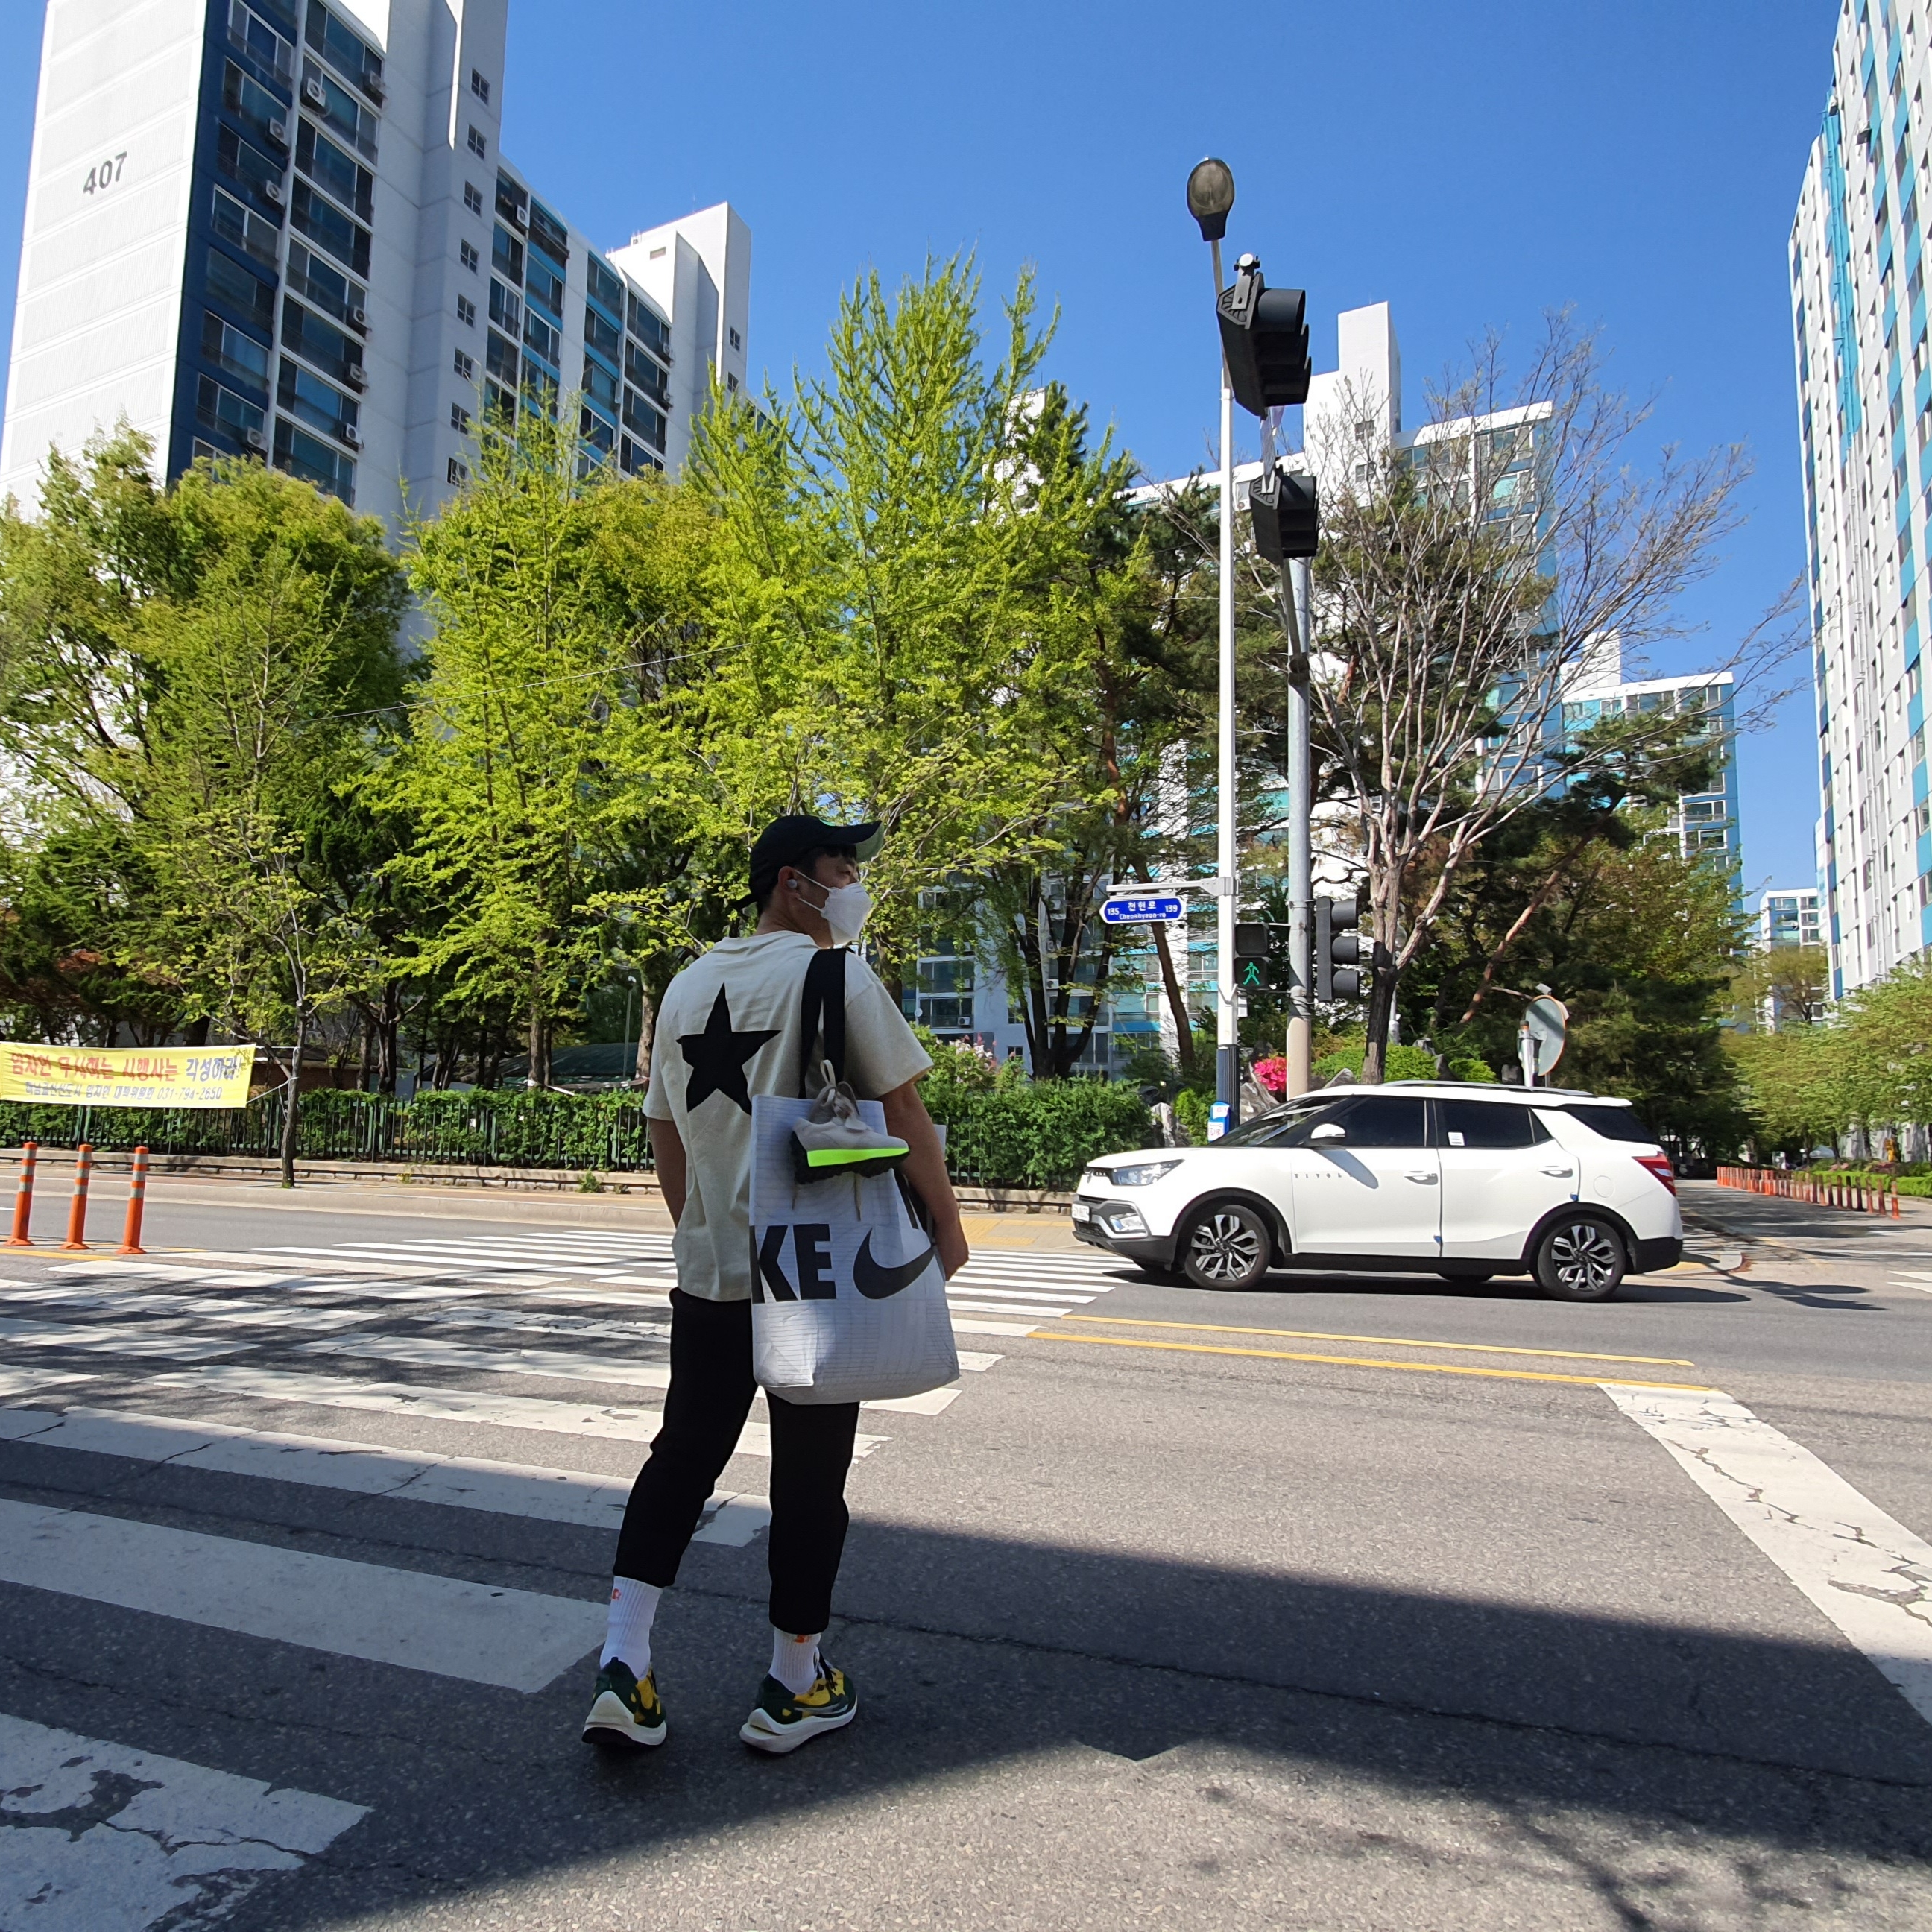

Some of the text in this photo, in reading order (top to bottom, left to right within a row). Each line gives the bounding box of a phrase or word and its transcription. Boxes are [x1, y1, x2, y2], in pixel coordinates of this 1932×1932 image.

[83, 151, 127, 195] 407
[1107, 907, 1120, 915] 135
[1128, 900, 1157, 912] 천현로
[1164, 904, 1178, 913] 139
[58, 1055, 114, 1080] 무시하는
[123, 1058, 178, 1082] 시행사는
[157, 1086, 223, 1101] 031-794-2650
